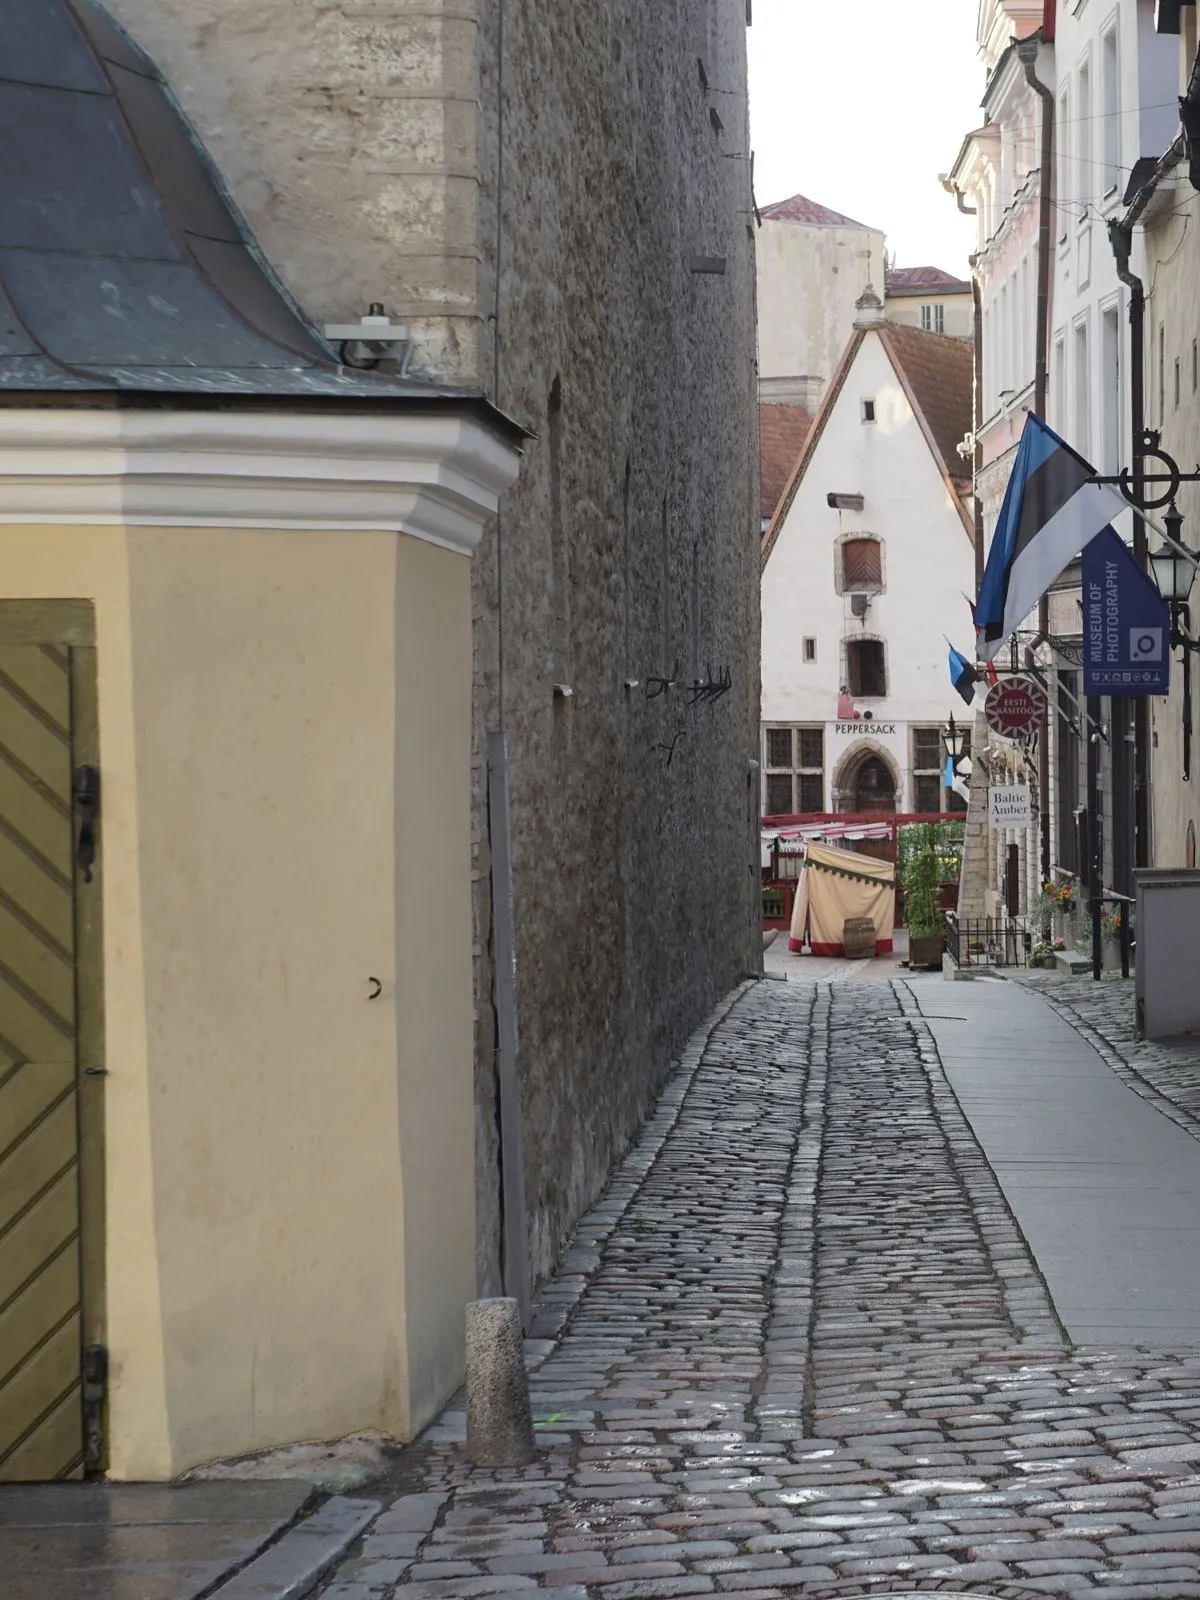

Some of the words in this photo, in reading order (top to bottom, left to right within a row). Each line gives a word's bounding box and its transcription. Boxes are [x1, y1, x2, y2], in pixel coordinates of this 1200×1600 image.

[1089, 582, 1102, 600] OF
[1105, 560, 1119, 662] PHOTOGRAPHY
[1089, 604, 1102, 662] MUSEUM
[1004, 698, 1027, 706] EESTI
[835, 724, 896, 734] PEPPERSACK
[994, 792, 1026, 803] Baltic
[992, 804, 1028, 815] Amber
